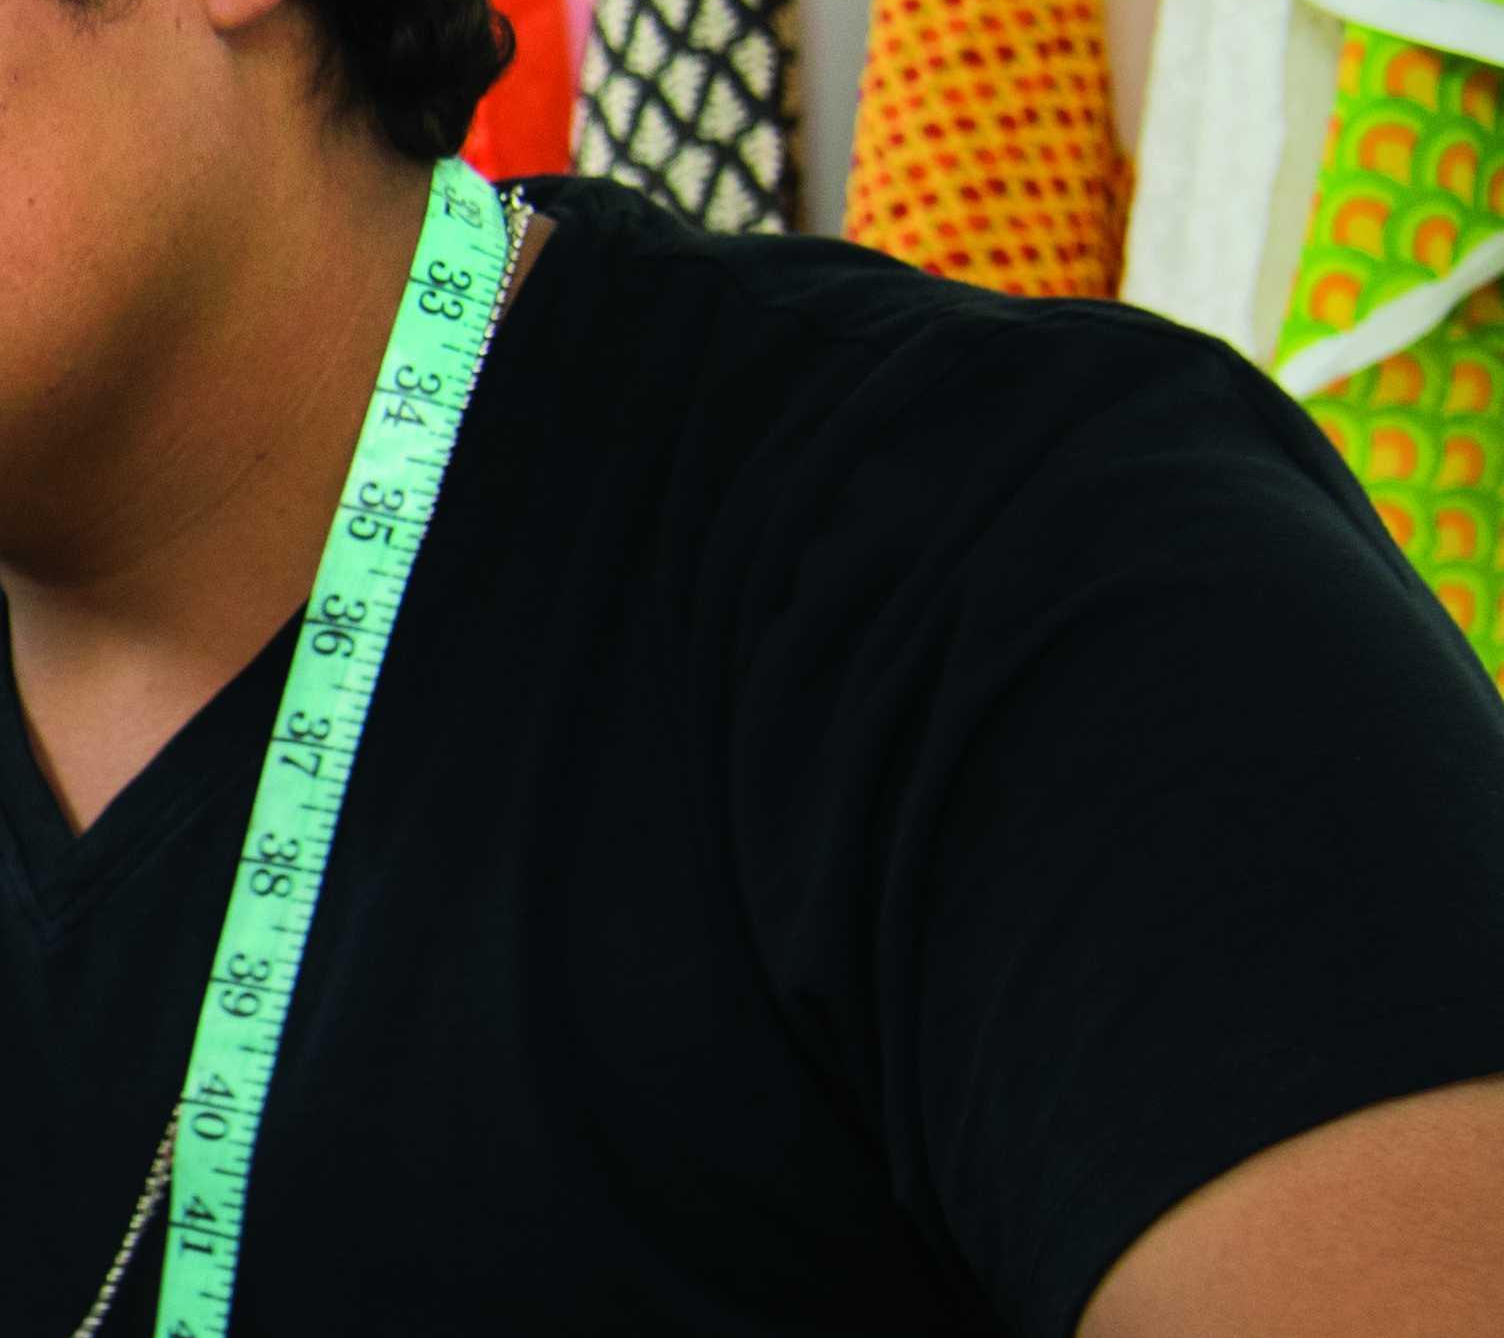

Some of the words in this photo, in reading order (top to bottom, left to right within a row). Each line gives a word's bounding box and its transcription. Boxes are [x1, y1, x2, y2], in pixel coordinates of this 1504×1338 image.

[418, 260, 473, 321] 33
[382, 364, 442, 429] 34
[348, 480, 406, 545] 35
[311, 593, 367, 659] 36
[279, 711, 331, 778] 37
[250, 831, 301, 898] 38
[219, 952, 271, 1017] 39
[191, 1072, 236, 1141] 40
[180, 1194, 217, 1255] 41
